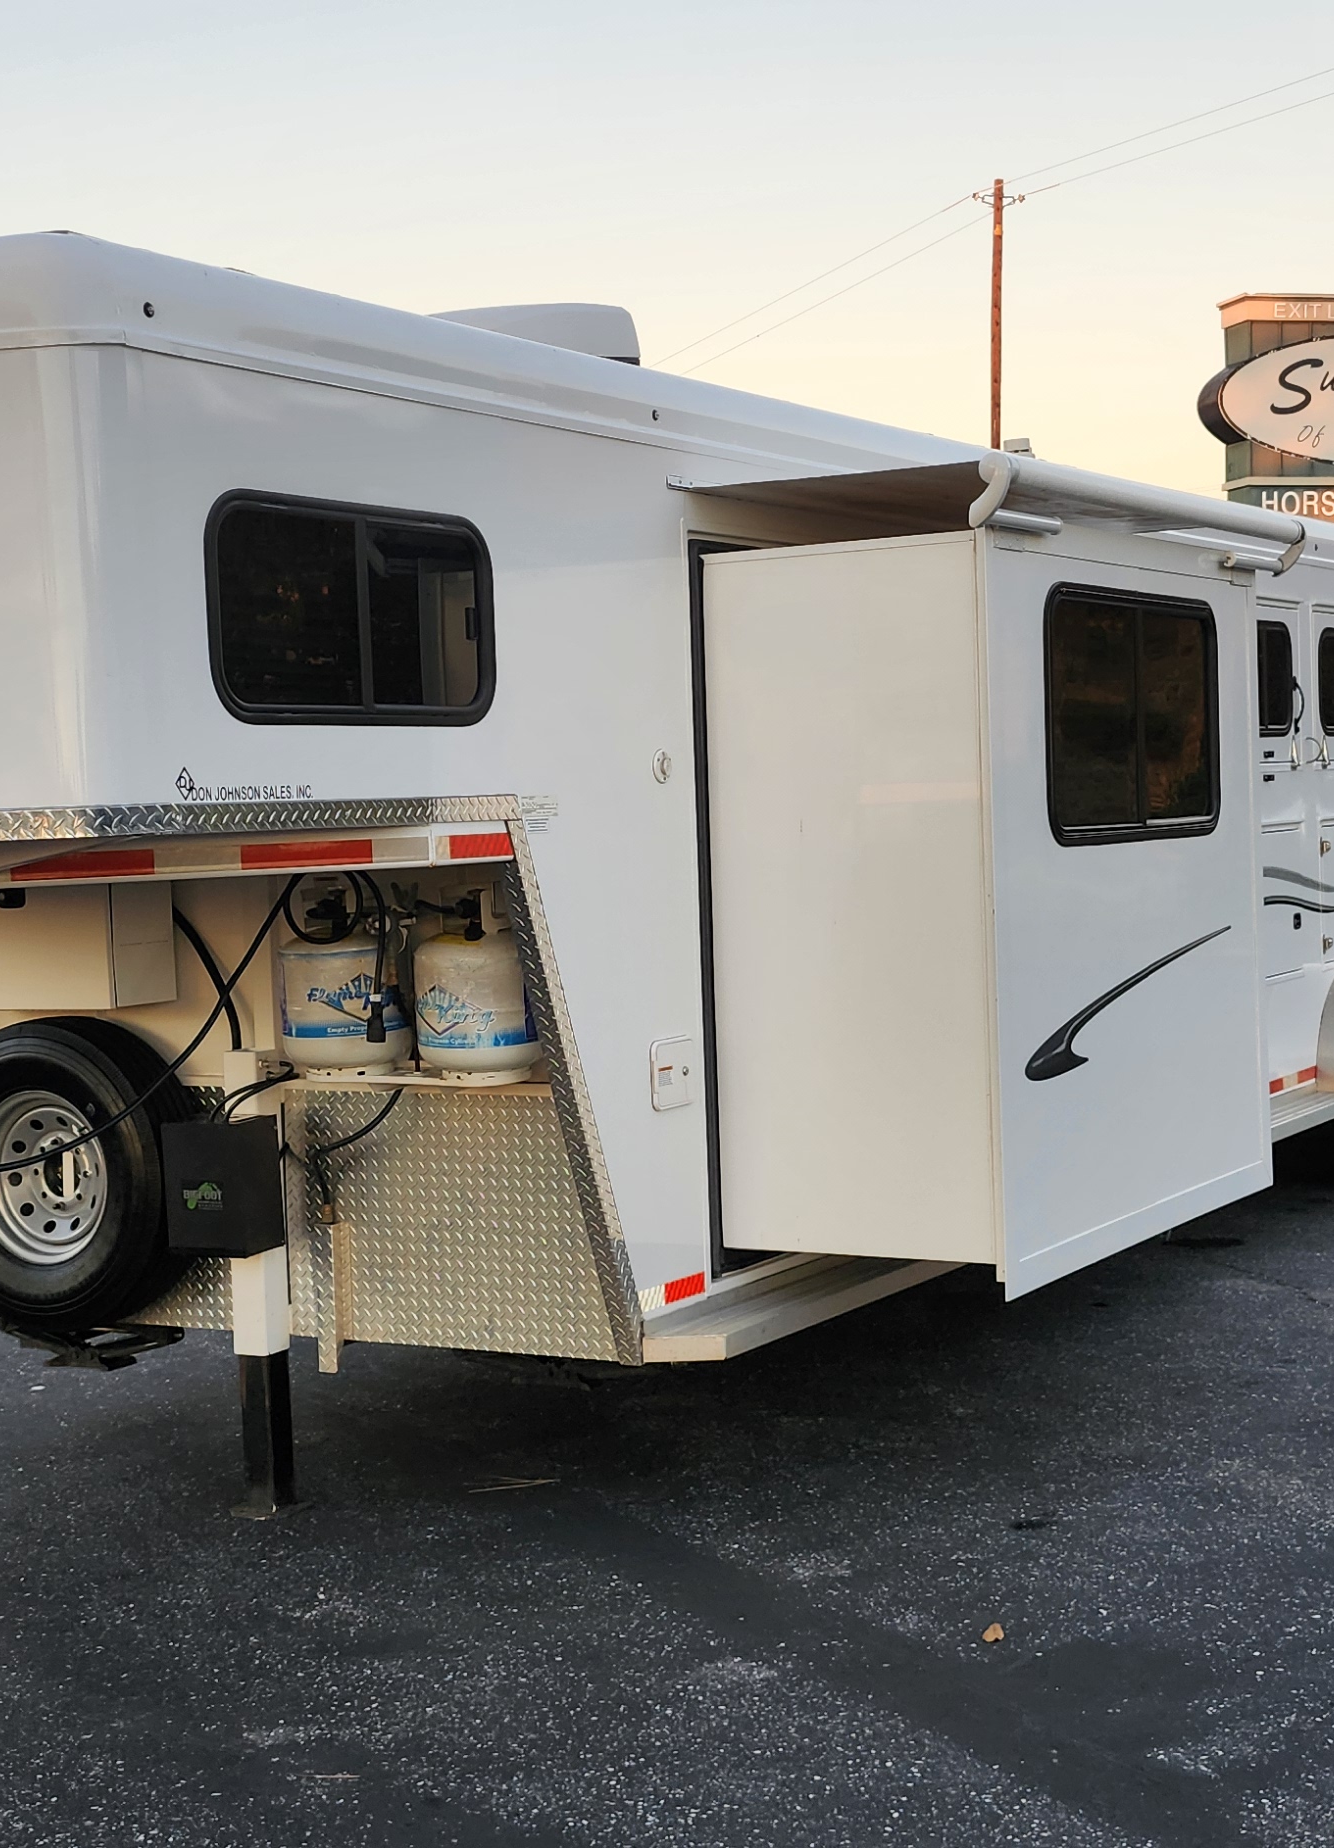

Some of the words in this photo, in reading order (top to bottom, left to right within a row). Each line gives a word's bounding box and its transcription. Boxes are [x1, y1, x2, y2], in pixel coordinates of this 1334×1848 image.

[1273, 302, 1322, 319] EXIT
[1297, 425, 1327, 448] Of
[191, 786, 212, 801] DON
[215, 785, 261, 800] JOHNSON
[296, 784, 314, 799] INC.
